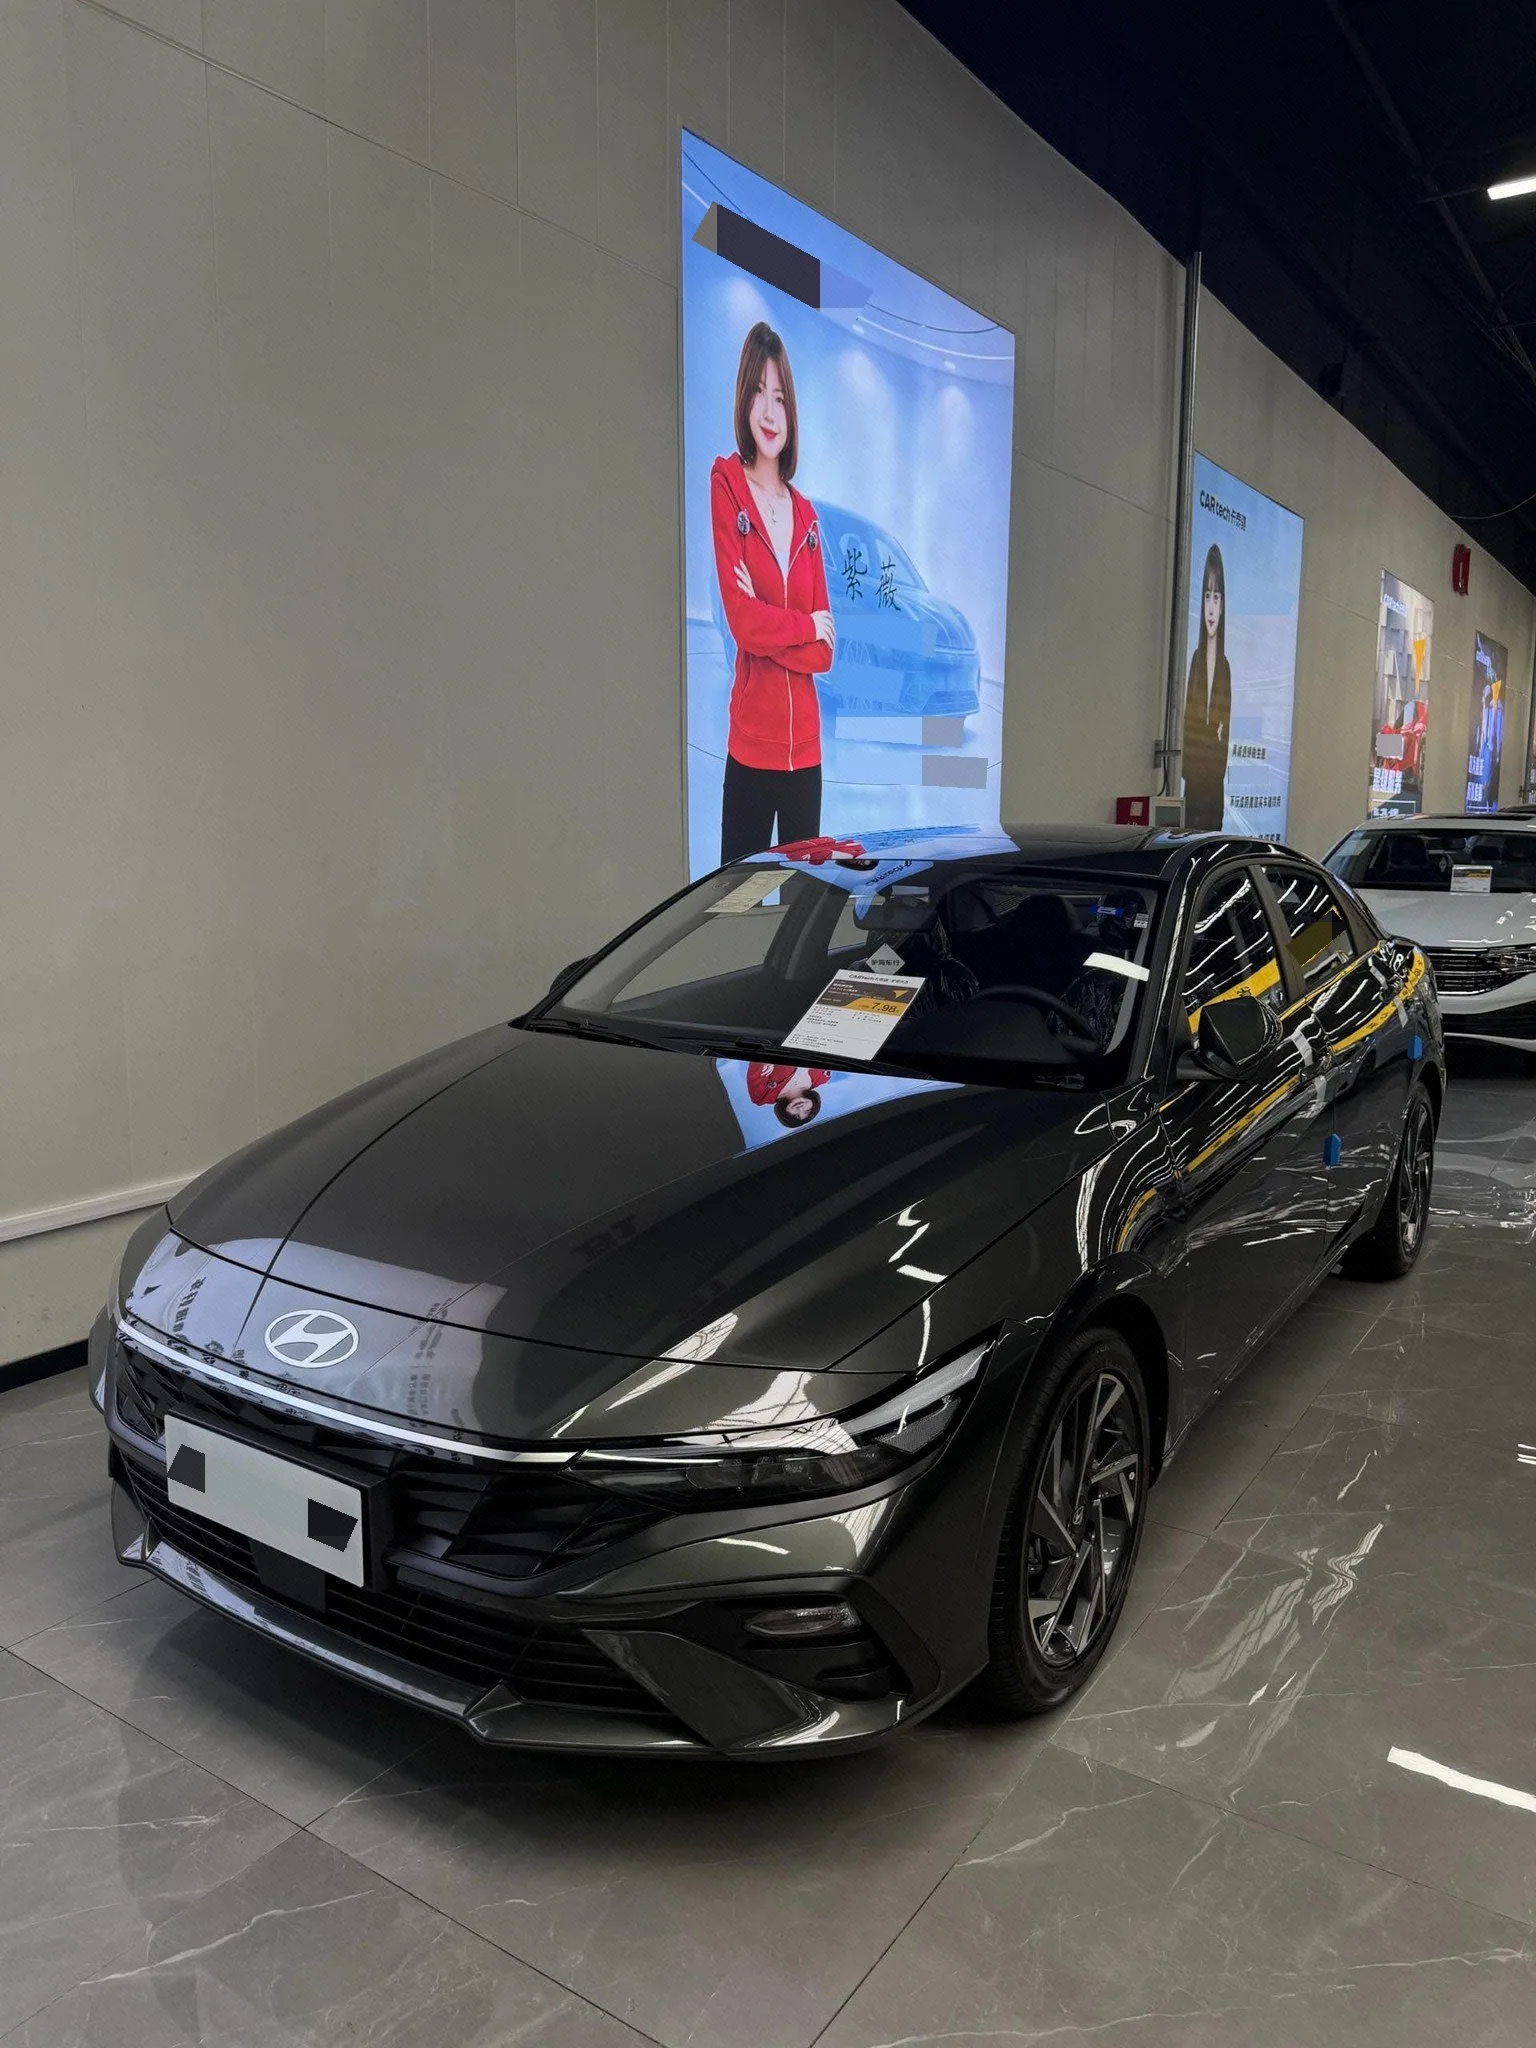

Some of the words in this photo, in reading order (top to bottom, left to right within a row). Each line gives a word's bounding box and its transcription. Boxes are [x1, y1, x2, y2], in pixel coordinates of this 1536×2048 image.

[1200, 490, 1231, 522] CARtech
[841, 548, 901, 611] 紫薇
[871, 1002, 897, 1013] 7.98
